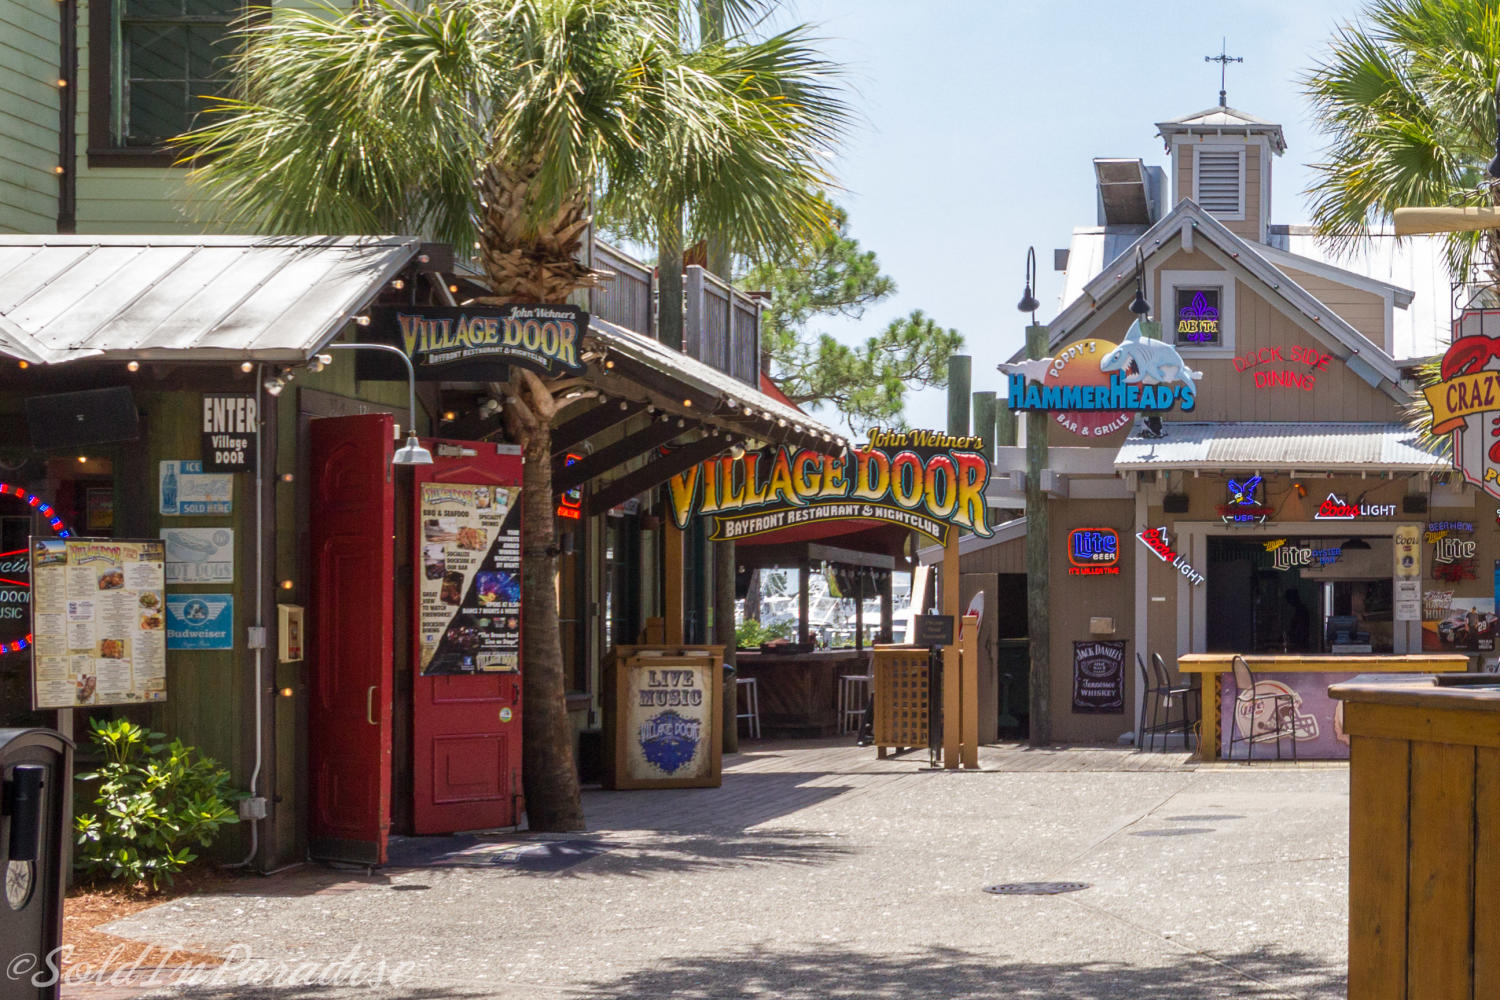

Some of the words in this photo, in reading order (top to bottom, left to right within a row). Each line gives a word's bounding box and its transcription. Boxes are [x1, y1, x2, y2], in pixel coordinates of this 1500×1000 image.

[510, 306, 534, 320] John
[397, 312, 500, 359] VILLAGE
[501, 317, 581, 368] DOOR
[1049, 341, 1097, 378] POPPY'S
[1232, 345, 1284, 373] DOCK
[1290, 345, 1334, 372] SIDE
[1254, 370, 1316, 392] DINING
[203, 397, 257, 433] ENTER
[1056, 413, 1078, 432] BAR
[1081, 426, 1090, 436] &
[1094, 413, 1130, 436] GRILLE
[211, 435, 248, 451] Village
[862, 426, 908, 453] John
[908, 429, 984, 450] Wehner's
[185, 462, 201, 472] ICE
[215, 451, 245, 464] DOOR
[668, 446, 850, 527] VILLAGE
[851, 447, 994, 538] DOOR
[184, 504, 205, 513] SOLD
[1319, 499, 1361, 517] Coors
[1360, 504, 1397, 517] LIGHT
[725, 512, 785, 538] BAYFRONT
[787, 504, 861, 524] RESTAURANT
[861, 504, 873, 517] &
[875, 506, 942, 538] NIGHTCLUB
[1073, 532, 1117, 559] Lite
[1142, 528, 1177, 562] Coors
[1173, 556, 1206, 586] LIGHT
[1435, 538, 1476, 564] Lite
[1272, 546, 1312, 571] Lite
[167, 629, 227, 639] Budweiser
[1477, 620, 1487, 632] 29
[648, 670, 694, 687] LIVE
[639, 689, 703, 707] MUSIC
